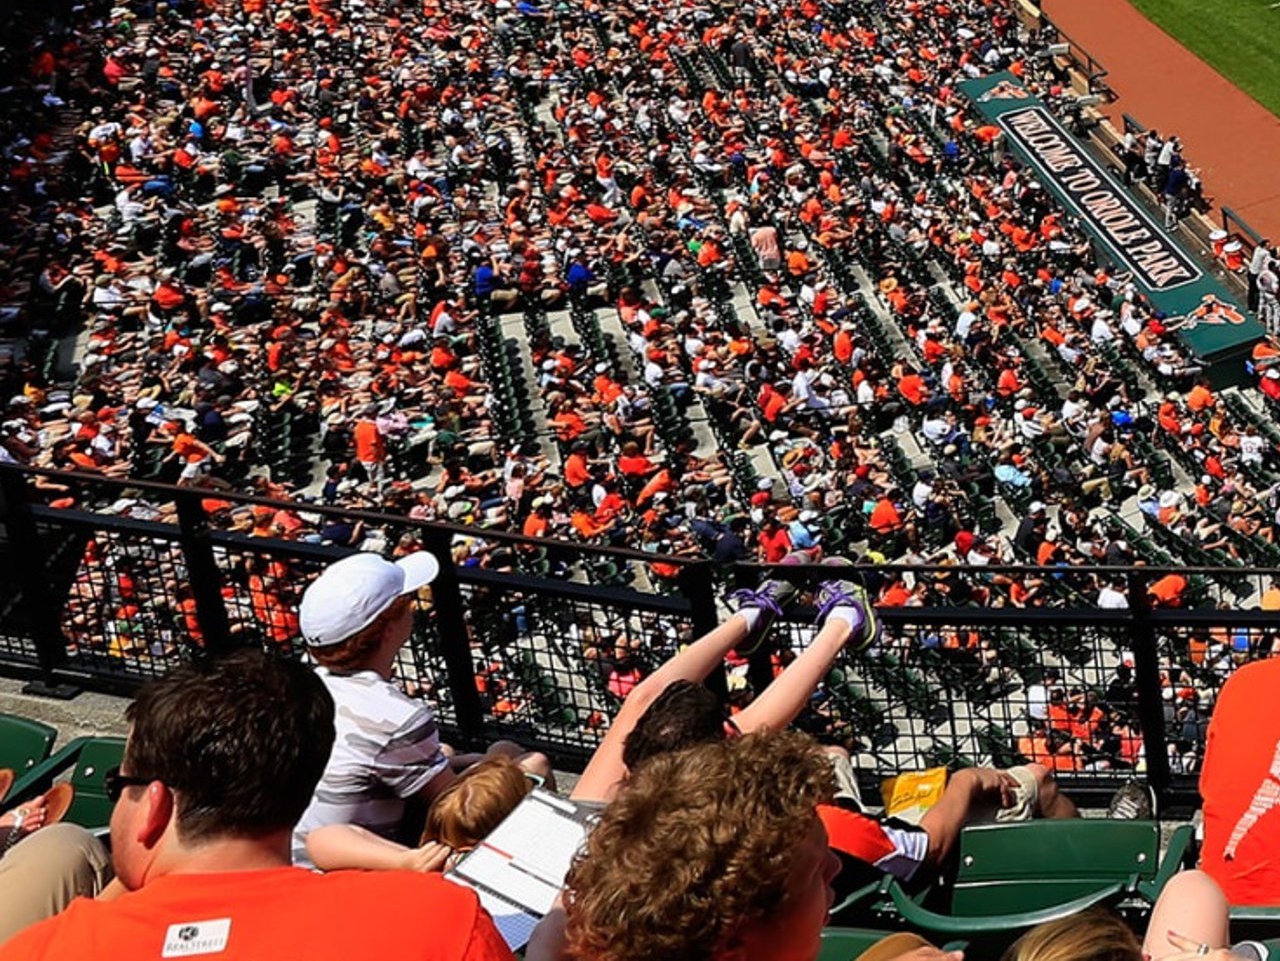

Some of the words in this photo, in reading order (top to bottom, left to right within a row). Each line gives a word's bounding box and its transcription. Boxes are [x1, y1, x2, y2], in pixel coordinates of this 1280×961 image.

[1005, 108, 1077, 173] WELCOME
[1060, 166, 1100, 192] TO
[1079, 189, 1149, 249] ORIOLE
[1133, 241, 1193, 287] PARK
